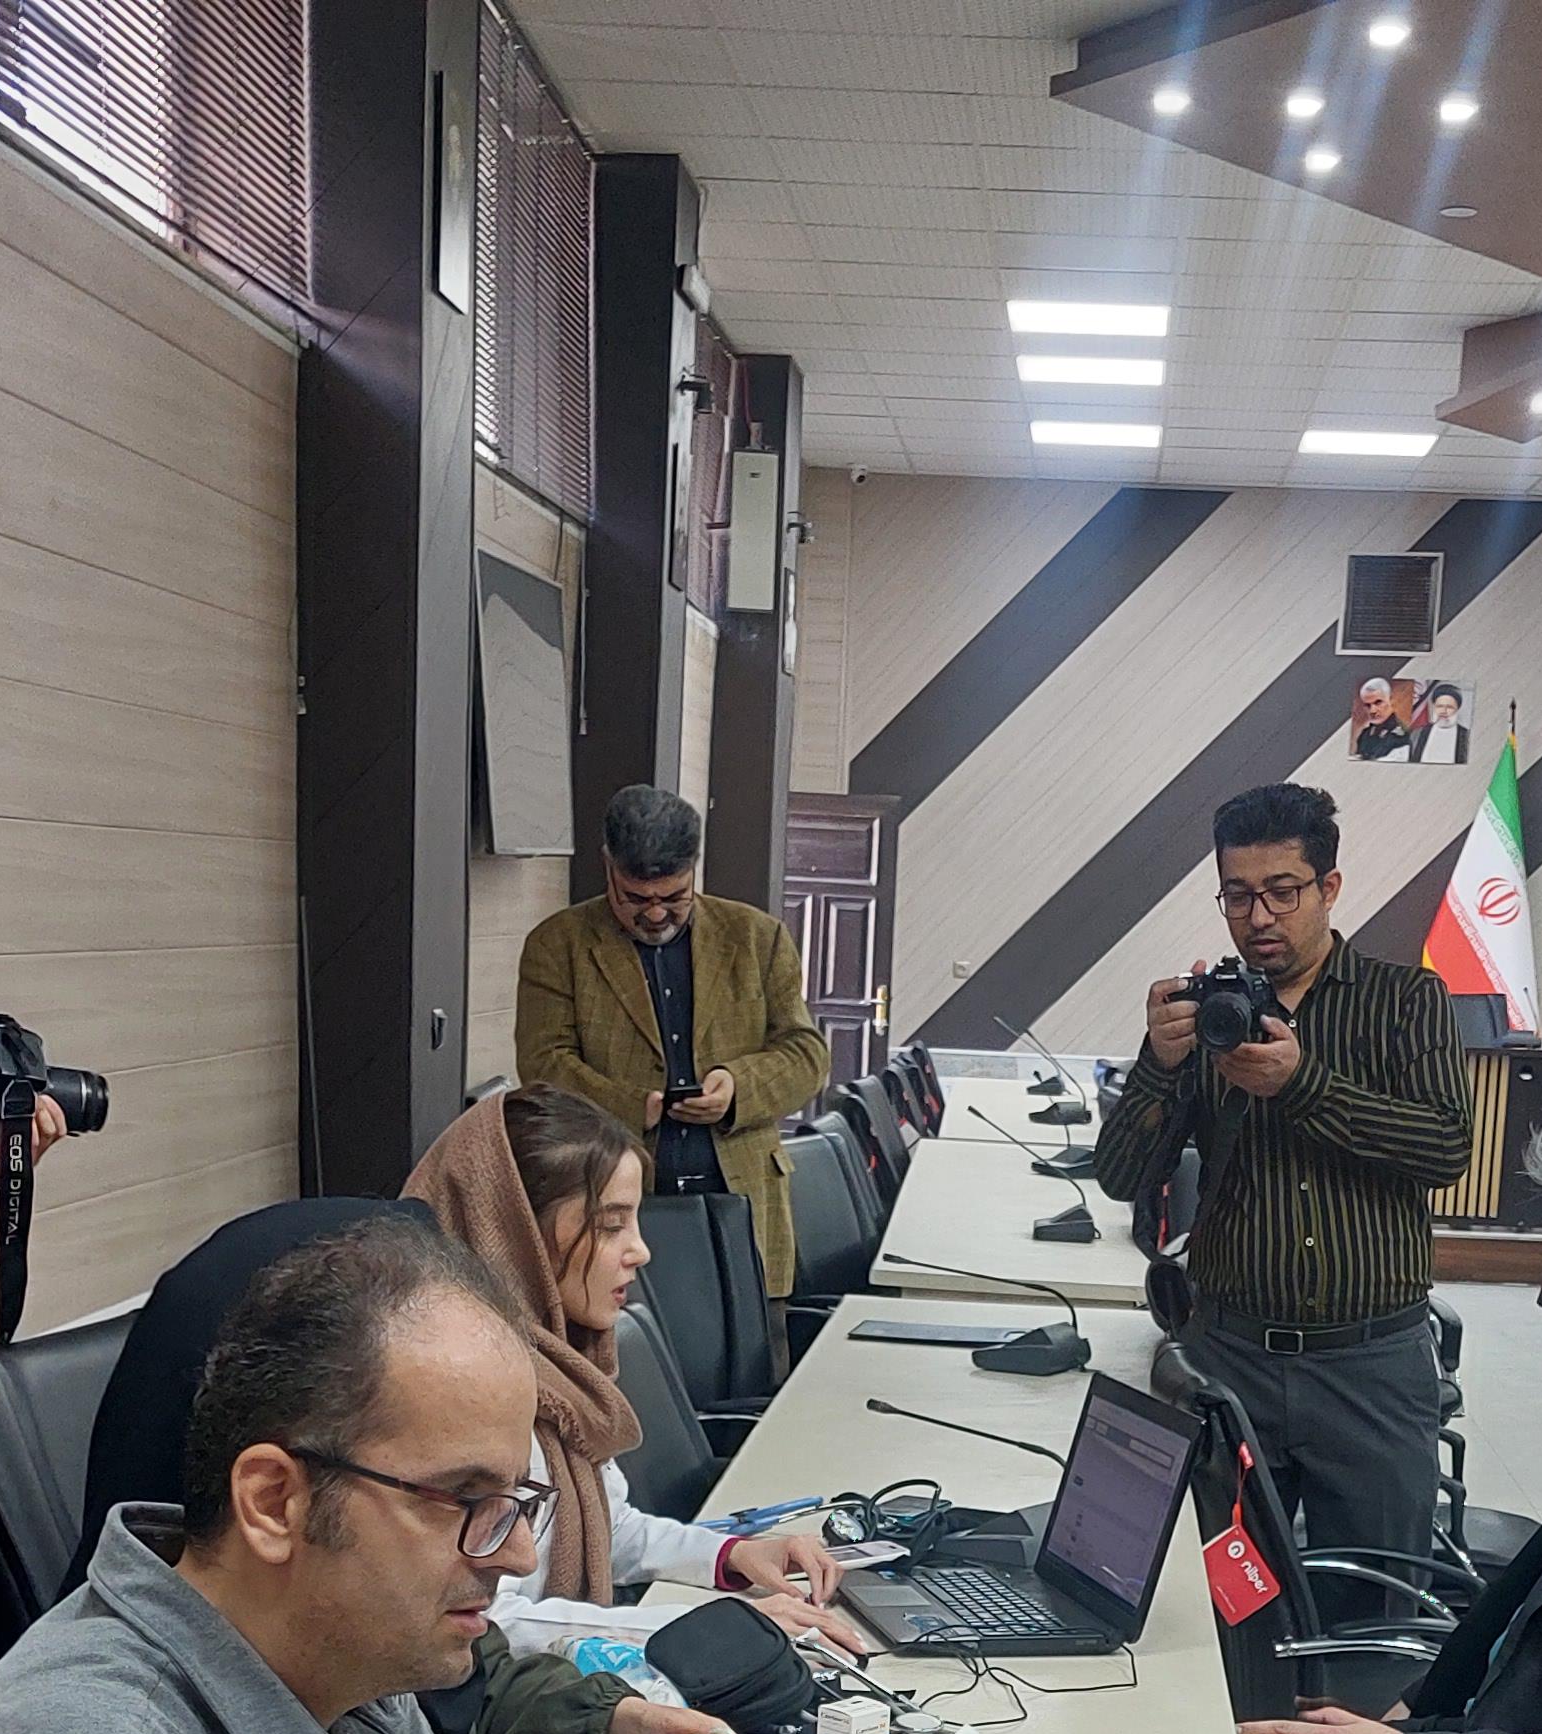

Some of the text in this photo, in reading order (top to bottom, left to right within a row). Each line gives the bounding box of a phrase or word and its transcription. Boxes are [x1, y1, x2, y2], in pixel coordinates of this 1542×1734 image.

[6, 1133, 23, 1245] EOS DIGITAL
[1240, 1561, 1269, 1594] nilper
